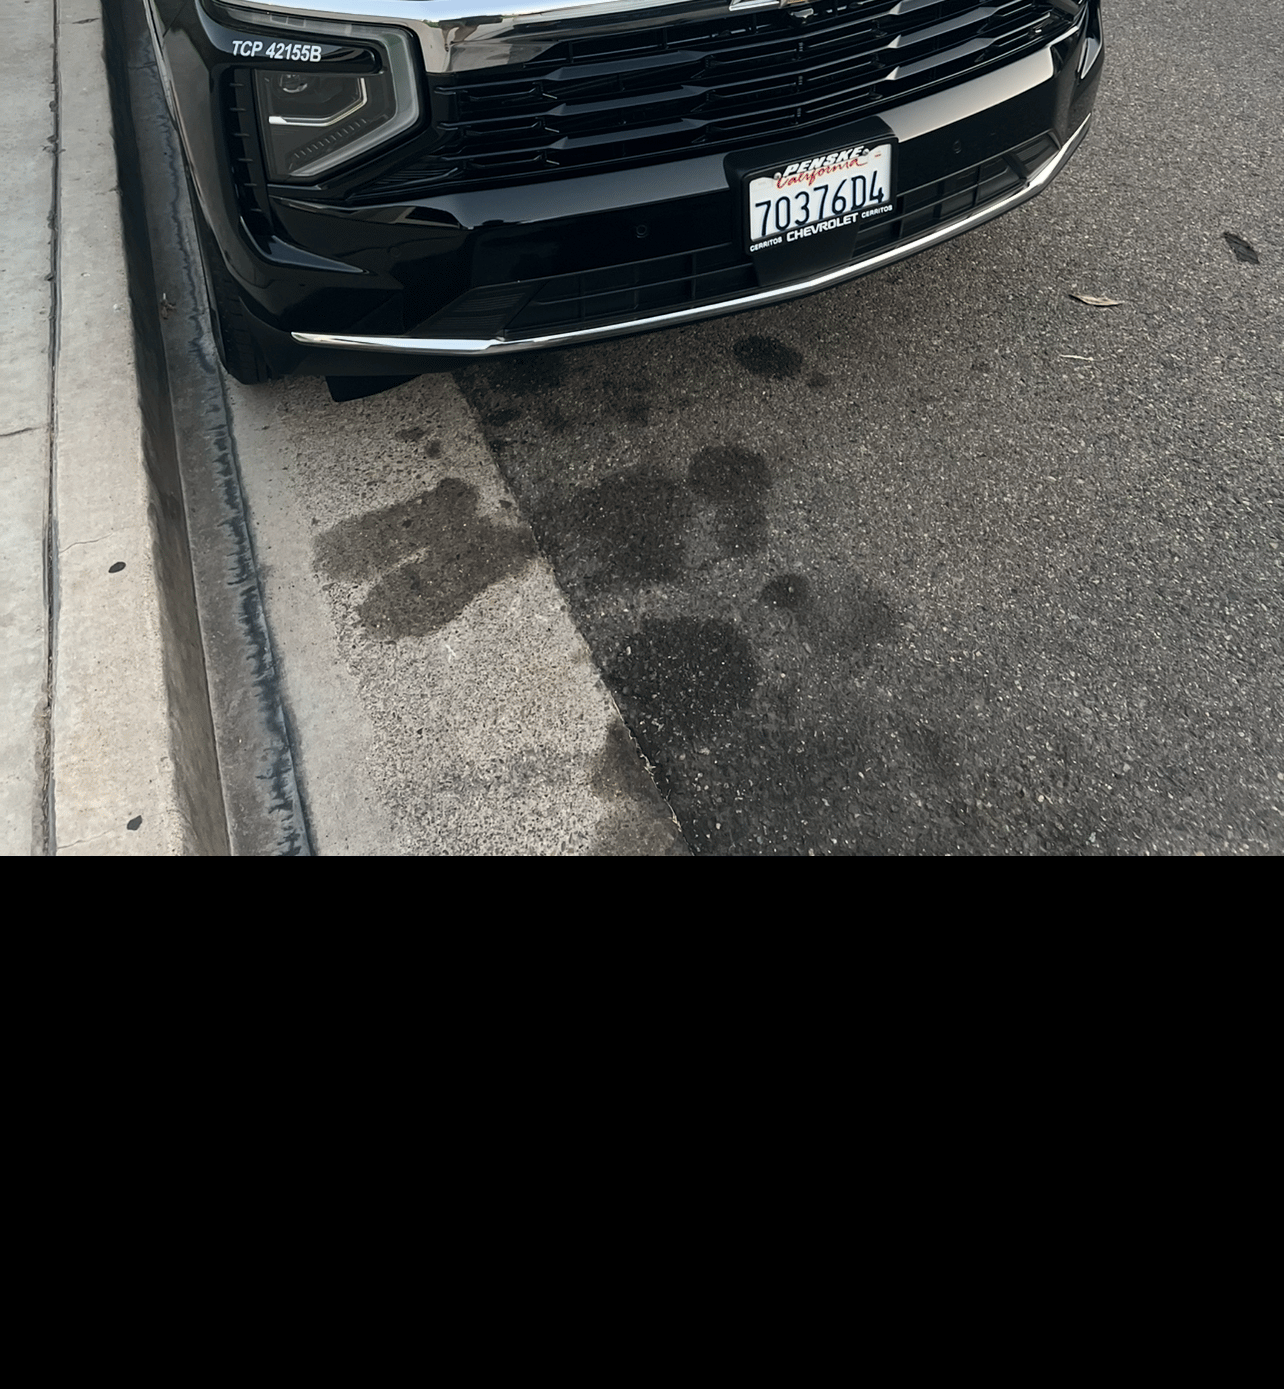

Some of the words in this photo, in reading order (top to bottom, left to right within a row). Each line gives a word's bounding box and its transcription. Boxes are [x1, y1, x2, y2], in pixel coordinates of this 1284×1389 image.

[232, 40, 263, 57] TCP
[265, 42, 322, 62] 42155B
[777, 158, 868, 189] California
[782, 146, 864, 177] PENSKE
[755, 170, 885, 237] 70376D4
[750, 236, 783, 252] CERRITOS
[786, 212, 859, 242] CHEVROLET
[861, 204, 893, 219] CERRITOS
